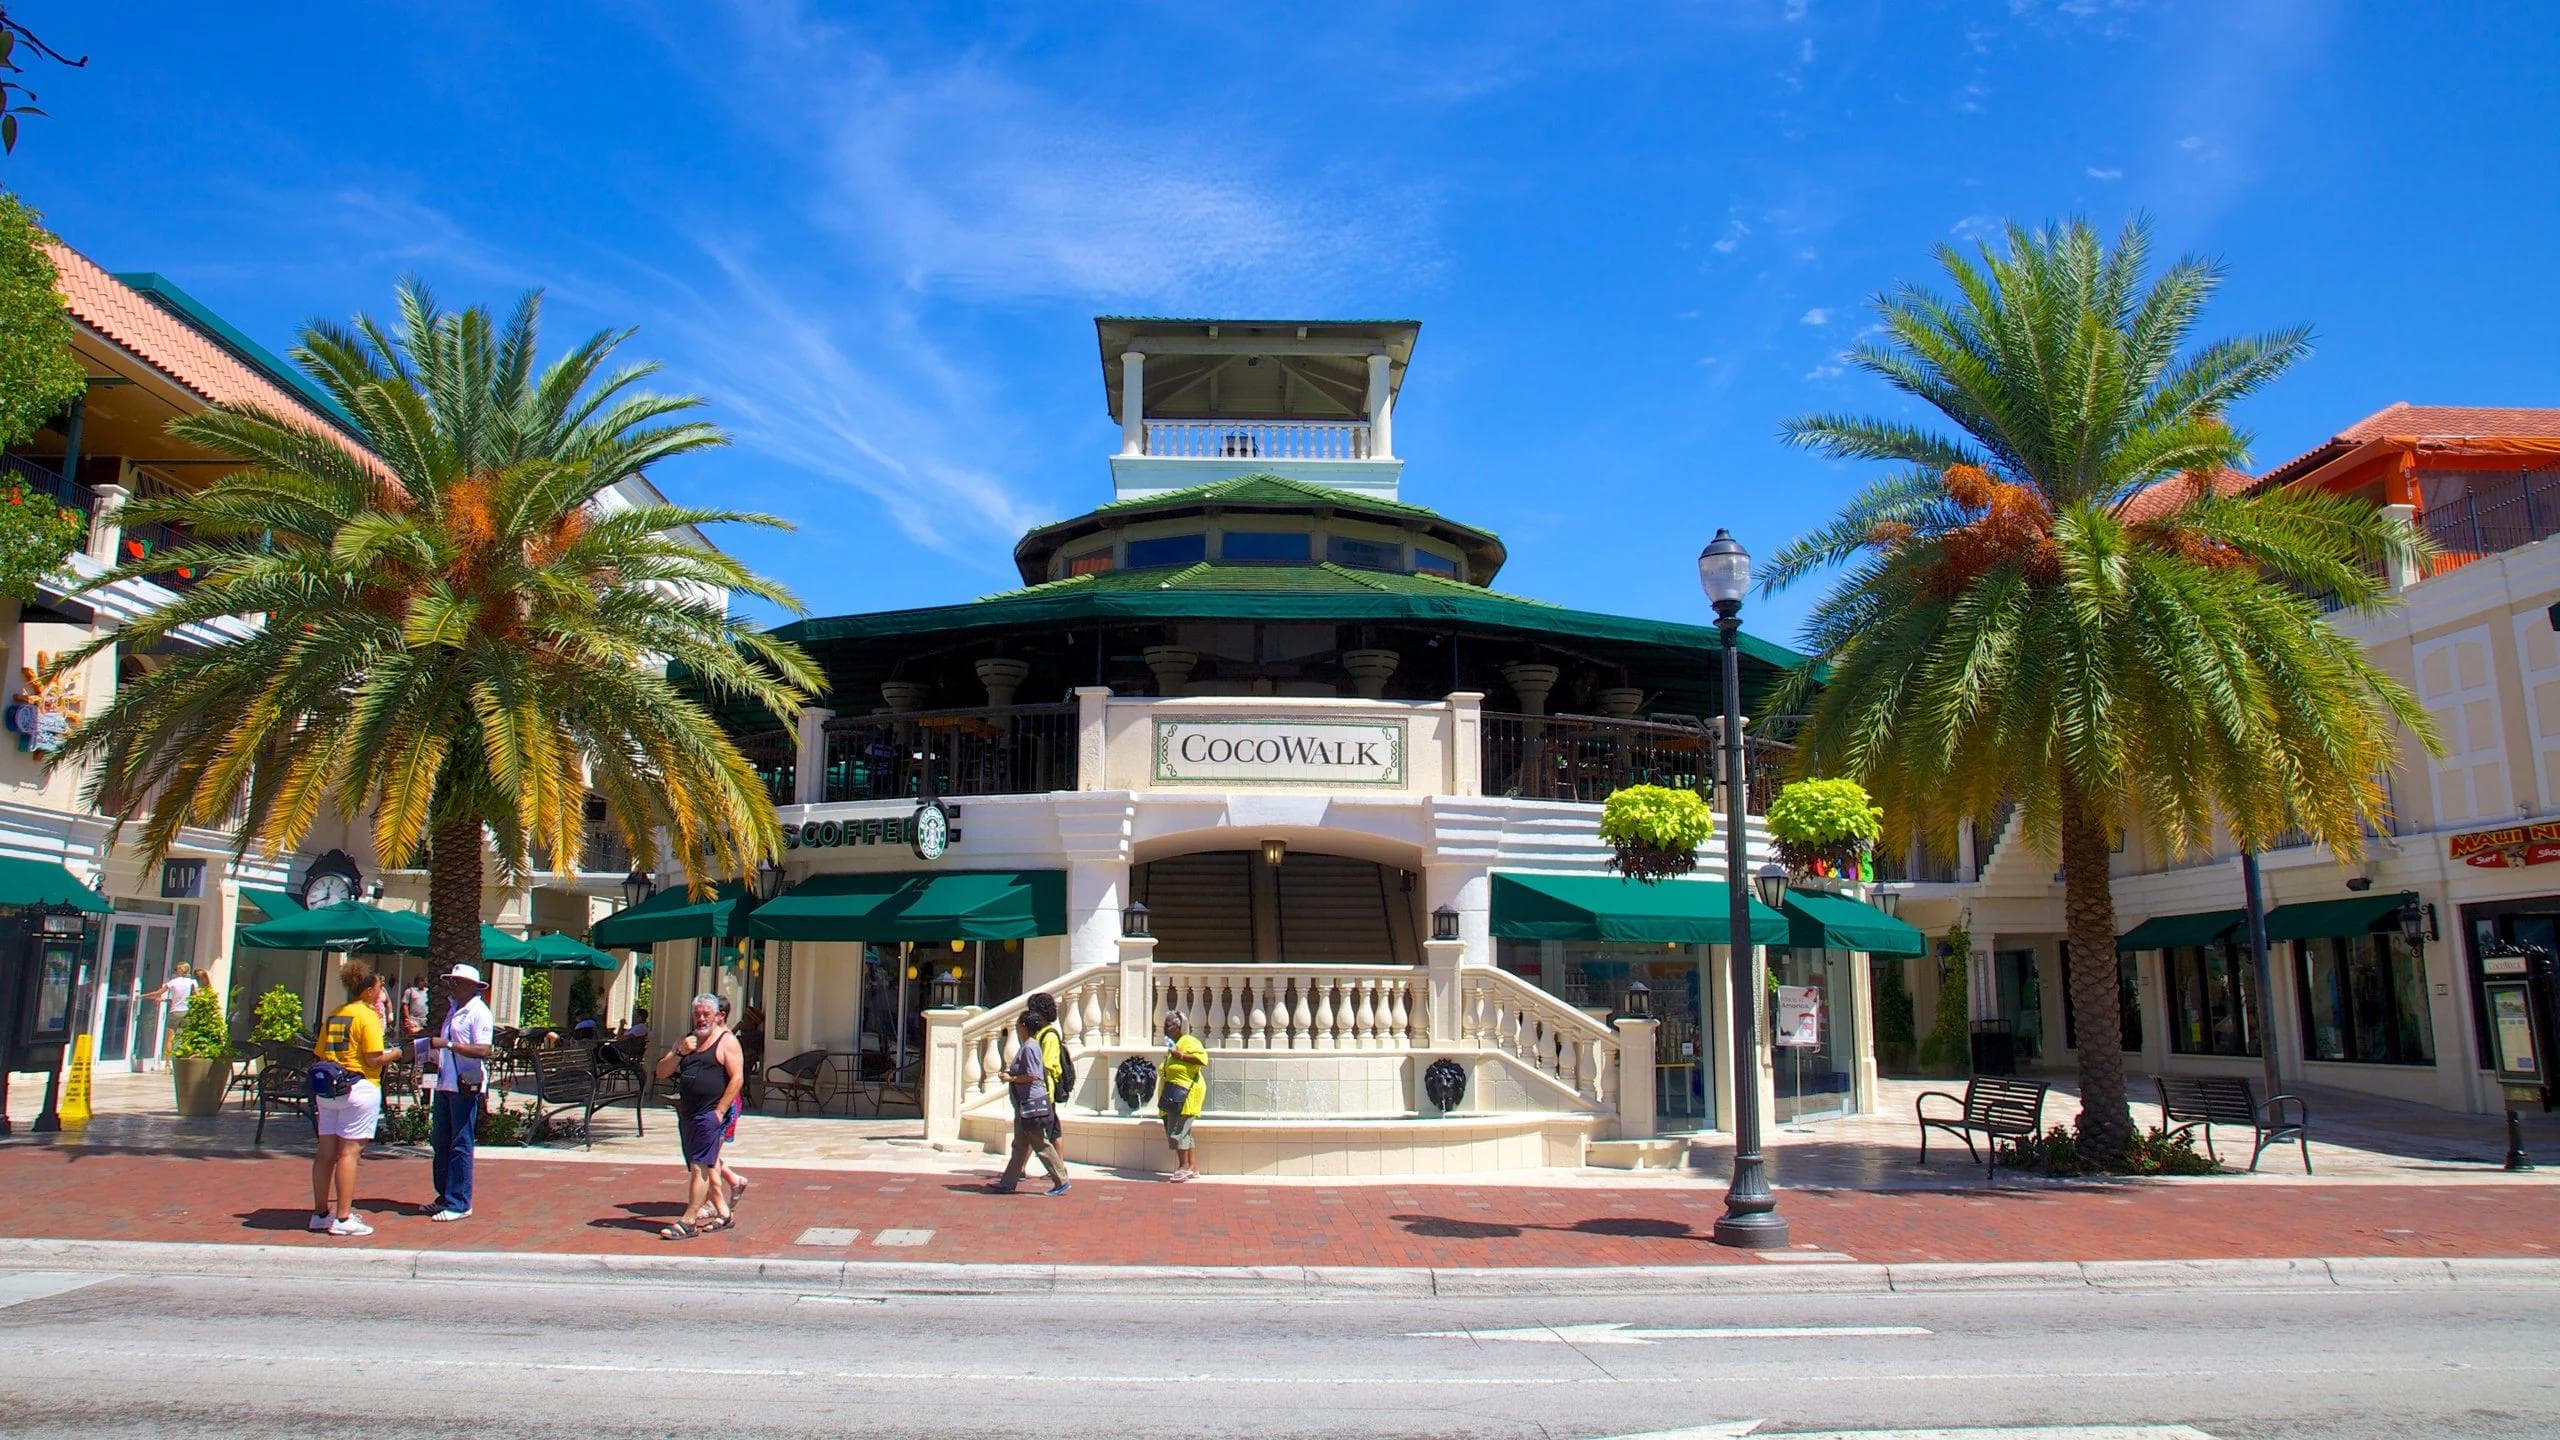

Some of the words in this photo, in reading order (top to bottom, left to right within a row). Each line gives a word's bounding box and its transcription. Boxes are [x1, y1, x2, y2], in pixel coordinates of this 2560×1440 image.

[1181, 733, 1382, 766] COCOWALK
[2448, 828, 2524, 860] MAUI
[2475, 854, 2498, 864] Surf
[168, 867, 196, 889] GAP
